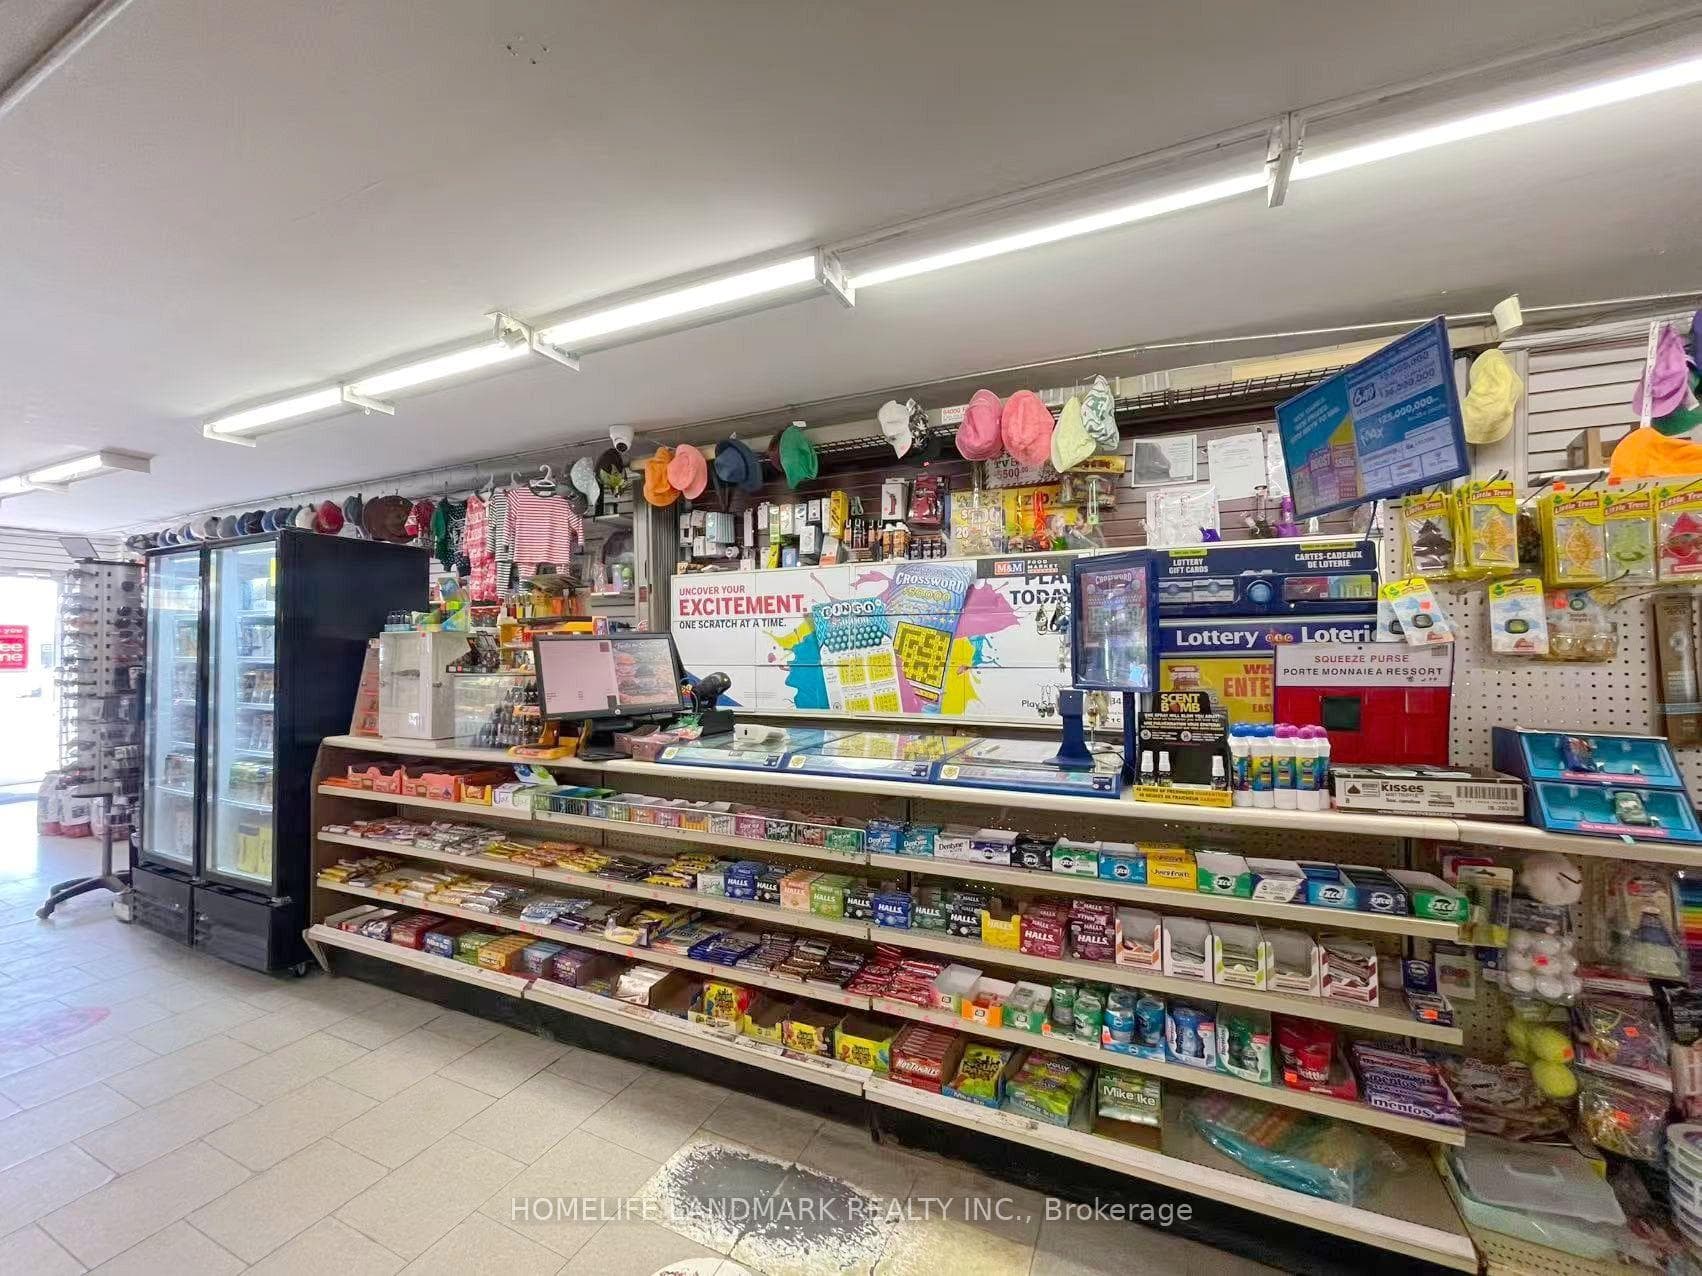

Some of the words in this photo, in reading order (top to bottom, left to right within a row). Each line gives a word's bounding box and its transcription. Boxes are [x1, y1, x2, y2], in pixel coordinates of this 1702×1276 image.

[1295, 550, 1363, 562] CARTES-CADEAUX
[996, 562, 1023, 573] M&M
[1173, 558, 1204, 567] LOTTERY
[1307, 561, 1318, 569] DE
[1319, 559, 1351, 569] LOTERIE
[1168, 566, 1185, 575] GIFT
[1186, 565, 1209, 574] CARDS
[895, 572, 964, 594] CROSSWORD
[679, 585, 720, 596] UNCOVER
[722, 584, 746, 594] YOUR
[679, 594, 808, 616] EXCITEMENT.
[822, 601, 875, 618] BINGO
[679, 620, 697, 629] ONE
[698, 618, 738, 629] SCRATCH
[740, 618, 751, 628] AT
[752, 618, 760, 628] A
[761, 617, 787, 628] TIME.
[1176, 629, 1260, 648] Lottery
[1314, 654, 1366, 664] SQUEEZE
[1370, 654, 1410, 663] PURSE
[1243, 663, 1274, 675] WH
[1283, 667, 1319, 677] PORTE
[1321, 667, 1374, 677] MONNAIE
[1375, 667, 1383, 676] A
[1385, 667, 1443, 676] RESSORT
[1223, 677, 1272, 697] ENTE
[1161, 693, 1201, 703] SCENT
[1021, 699, 1039, 709] Play
[938, 841, 964, 851] Dentyne
[728, 878, 749, 886] HALLS
[757, 882, 778, 890] HALLS
[813, 893, 836, 902] HALLS
[847, 897, 871, 907] HALLS
[878, 903, 904, 914] HALLS
[915, 906, 941, 916] HALLS
[950, 913, 978, 925] HALLS
[1024, 930, 1055, 942] HALLS
[1077, 934, 1109, 945] HALLS
[1103, 1085, 1134, 1100] Mike
[1137, 1093, 1156, 1106] Ike
[1373, 1098, 1433, 1117] mentos
